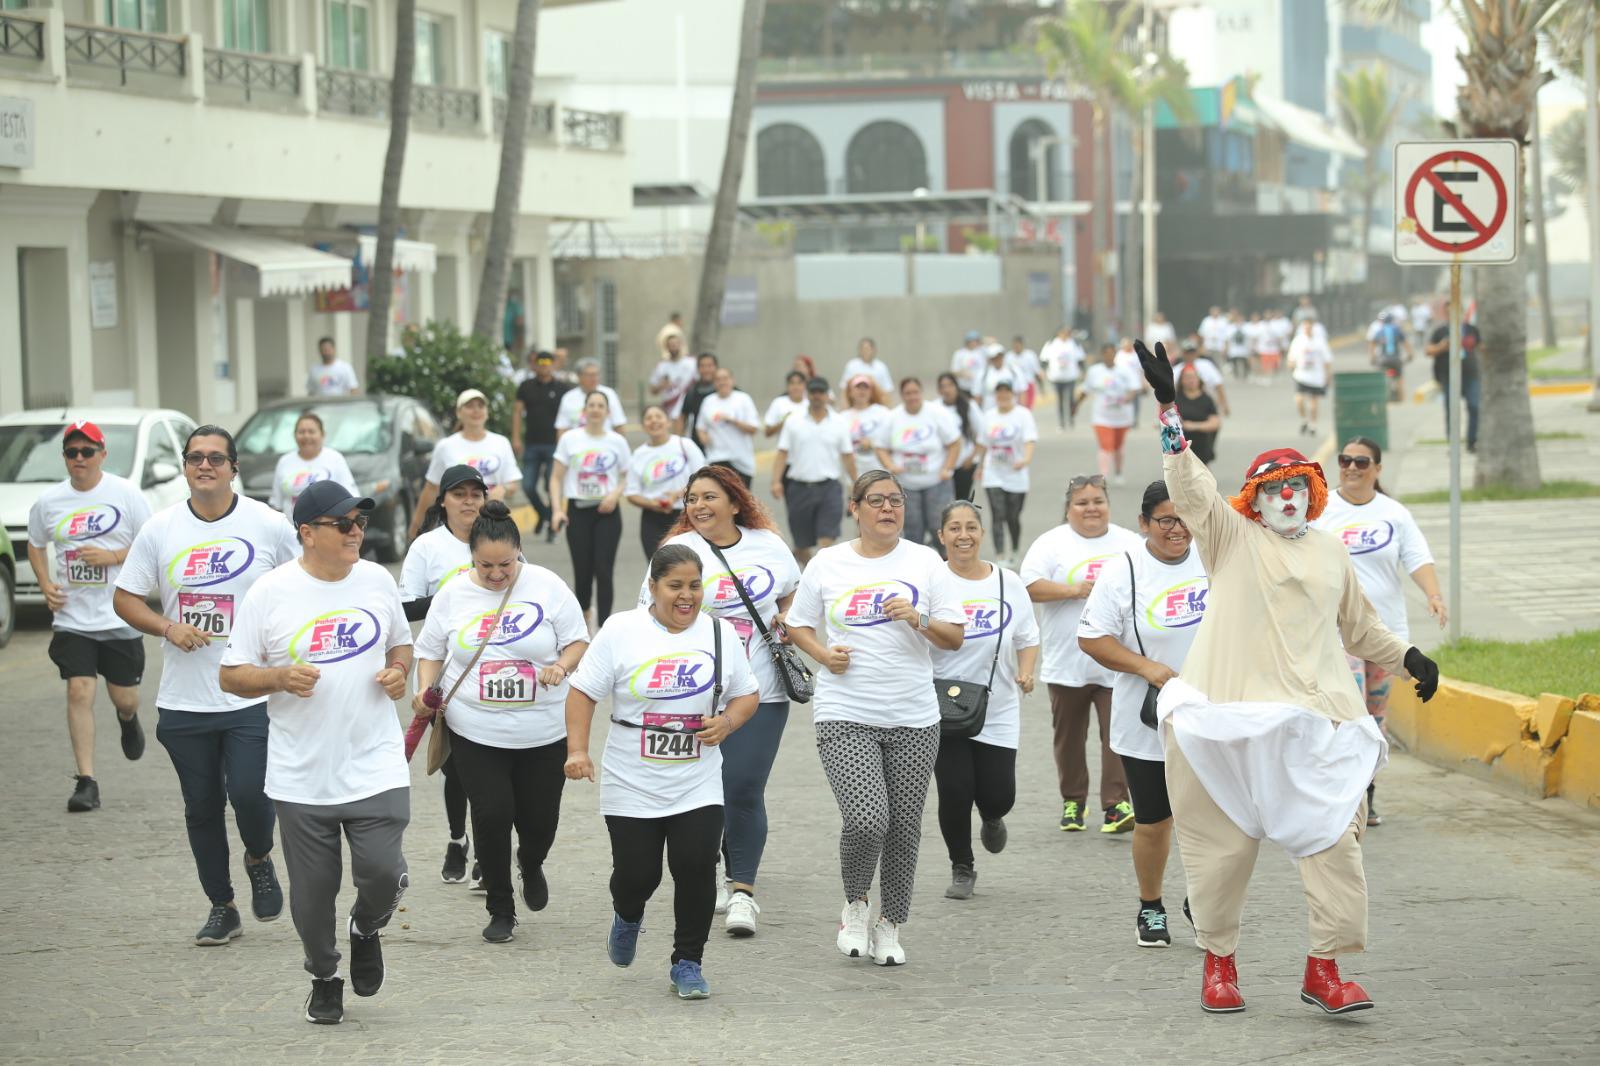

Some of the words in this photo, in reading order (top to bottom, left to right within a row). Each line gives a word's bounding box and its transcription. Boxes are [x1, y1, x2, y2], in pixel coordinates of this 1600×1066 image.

[963, 81, 1019, 100] VISTA
[1433, 171, 1478, 233] E
[68, 514, 105, 535] 5K
[70, 564, 103, 581] 1259
[183, 550, 236, 576] 5K
[845, 592, 899, 617] 5K
[1165, 588, 1208, 617] 5K
[183, 611, 224, 634] 1276
[477, 612, 525, 638] 5K
[308, 622, 363, 652] 5K
[485, 678, 525, 699] 1181
[647, 663, 703, 689] 5K
[646, 733, 694, 756] 1244
